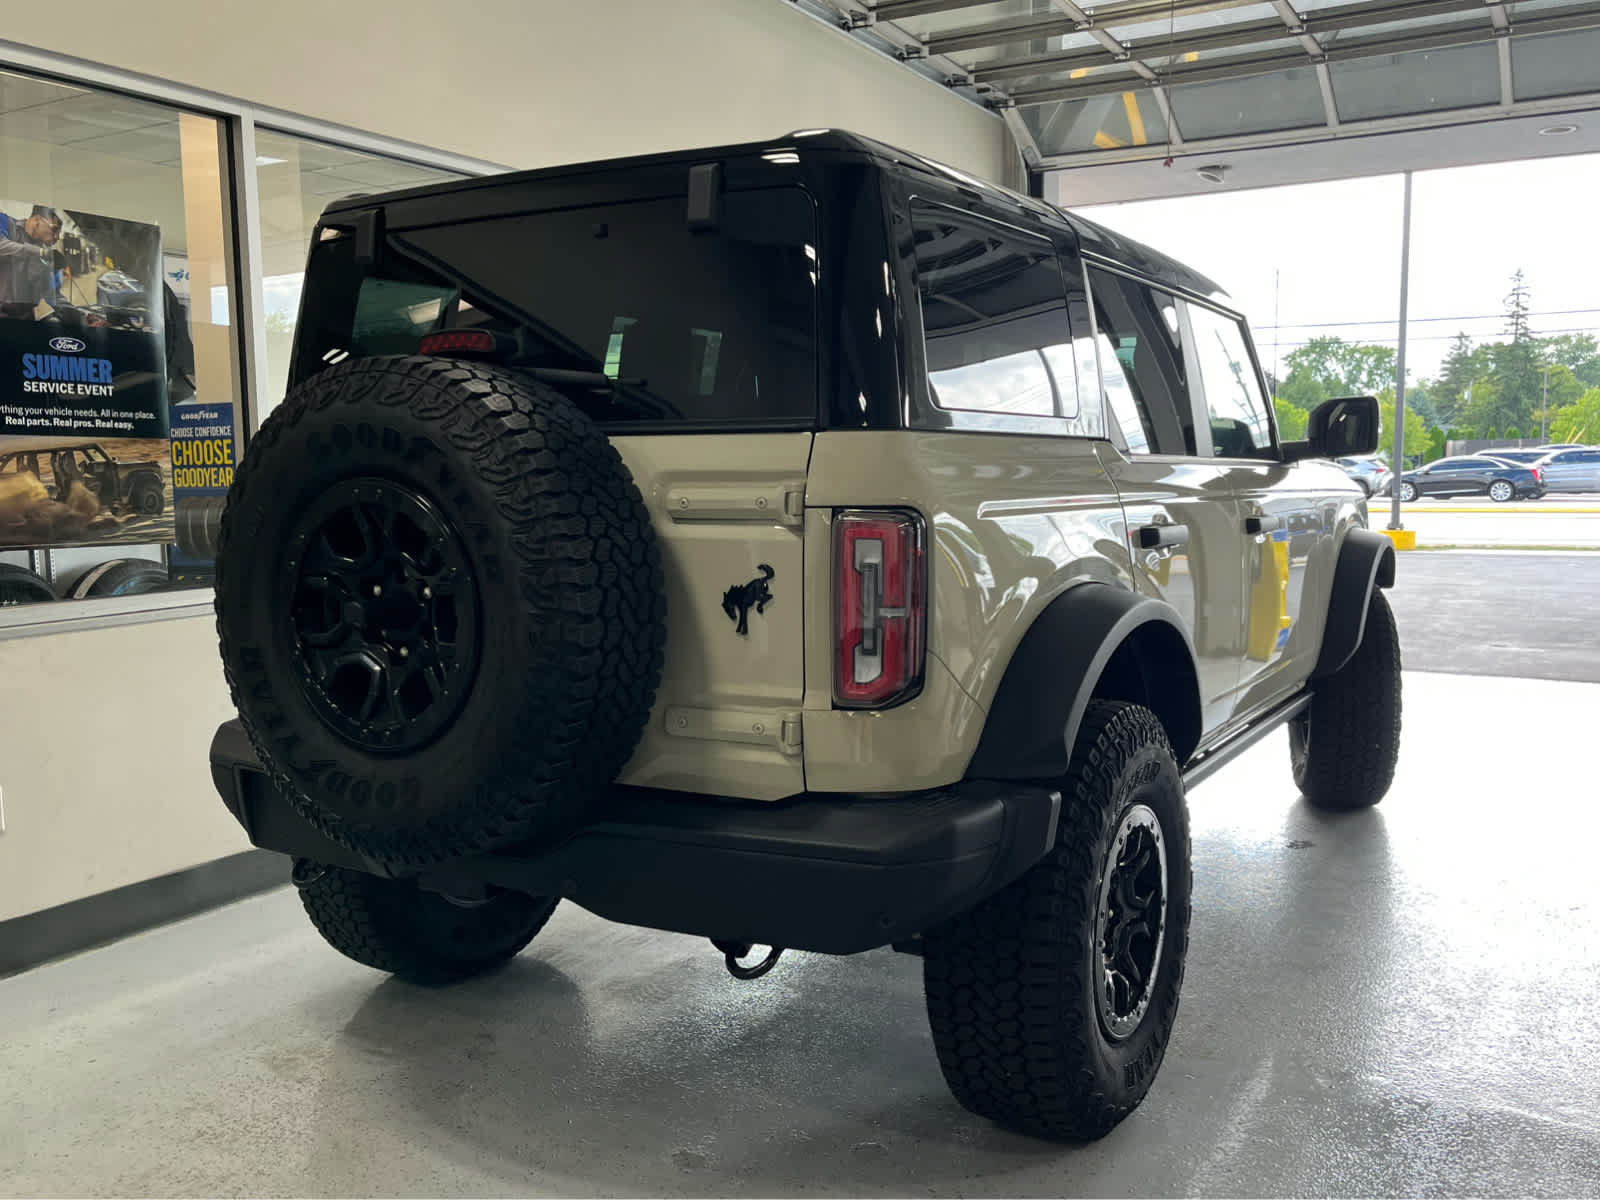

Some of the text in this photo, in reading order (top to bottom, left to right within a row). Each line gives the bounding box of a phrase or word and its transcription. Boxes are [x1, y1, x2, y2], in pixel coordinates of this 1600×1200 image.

[22, 353, 113, 384] SUMMER
[23, 381, 114, 397] SERVICE EVENT
[0, 404, 156, 420] thing your vehicle needs. All in one place.
[181, 410, 218, 421] GOODYEAR
[5, 415, 134, 431] Real parts. Real pros. Real easy.
[170, 425, 232, 438] CHOOSE CONFIDENCE
[172, 439, 234, 466] CHOOSE
[174, 467, 235, 488] GOODYEAR
